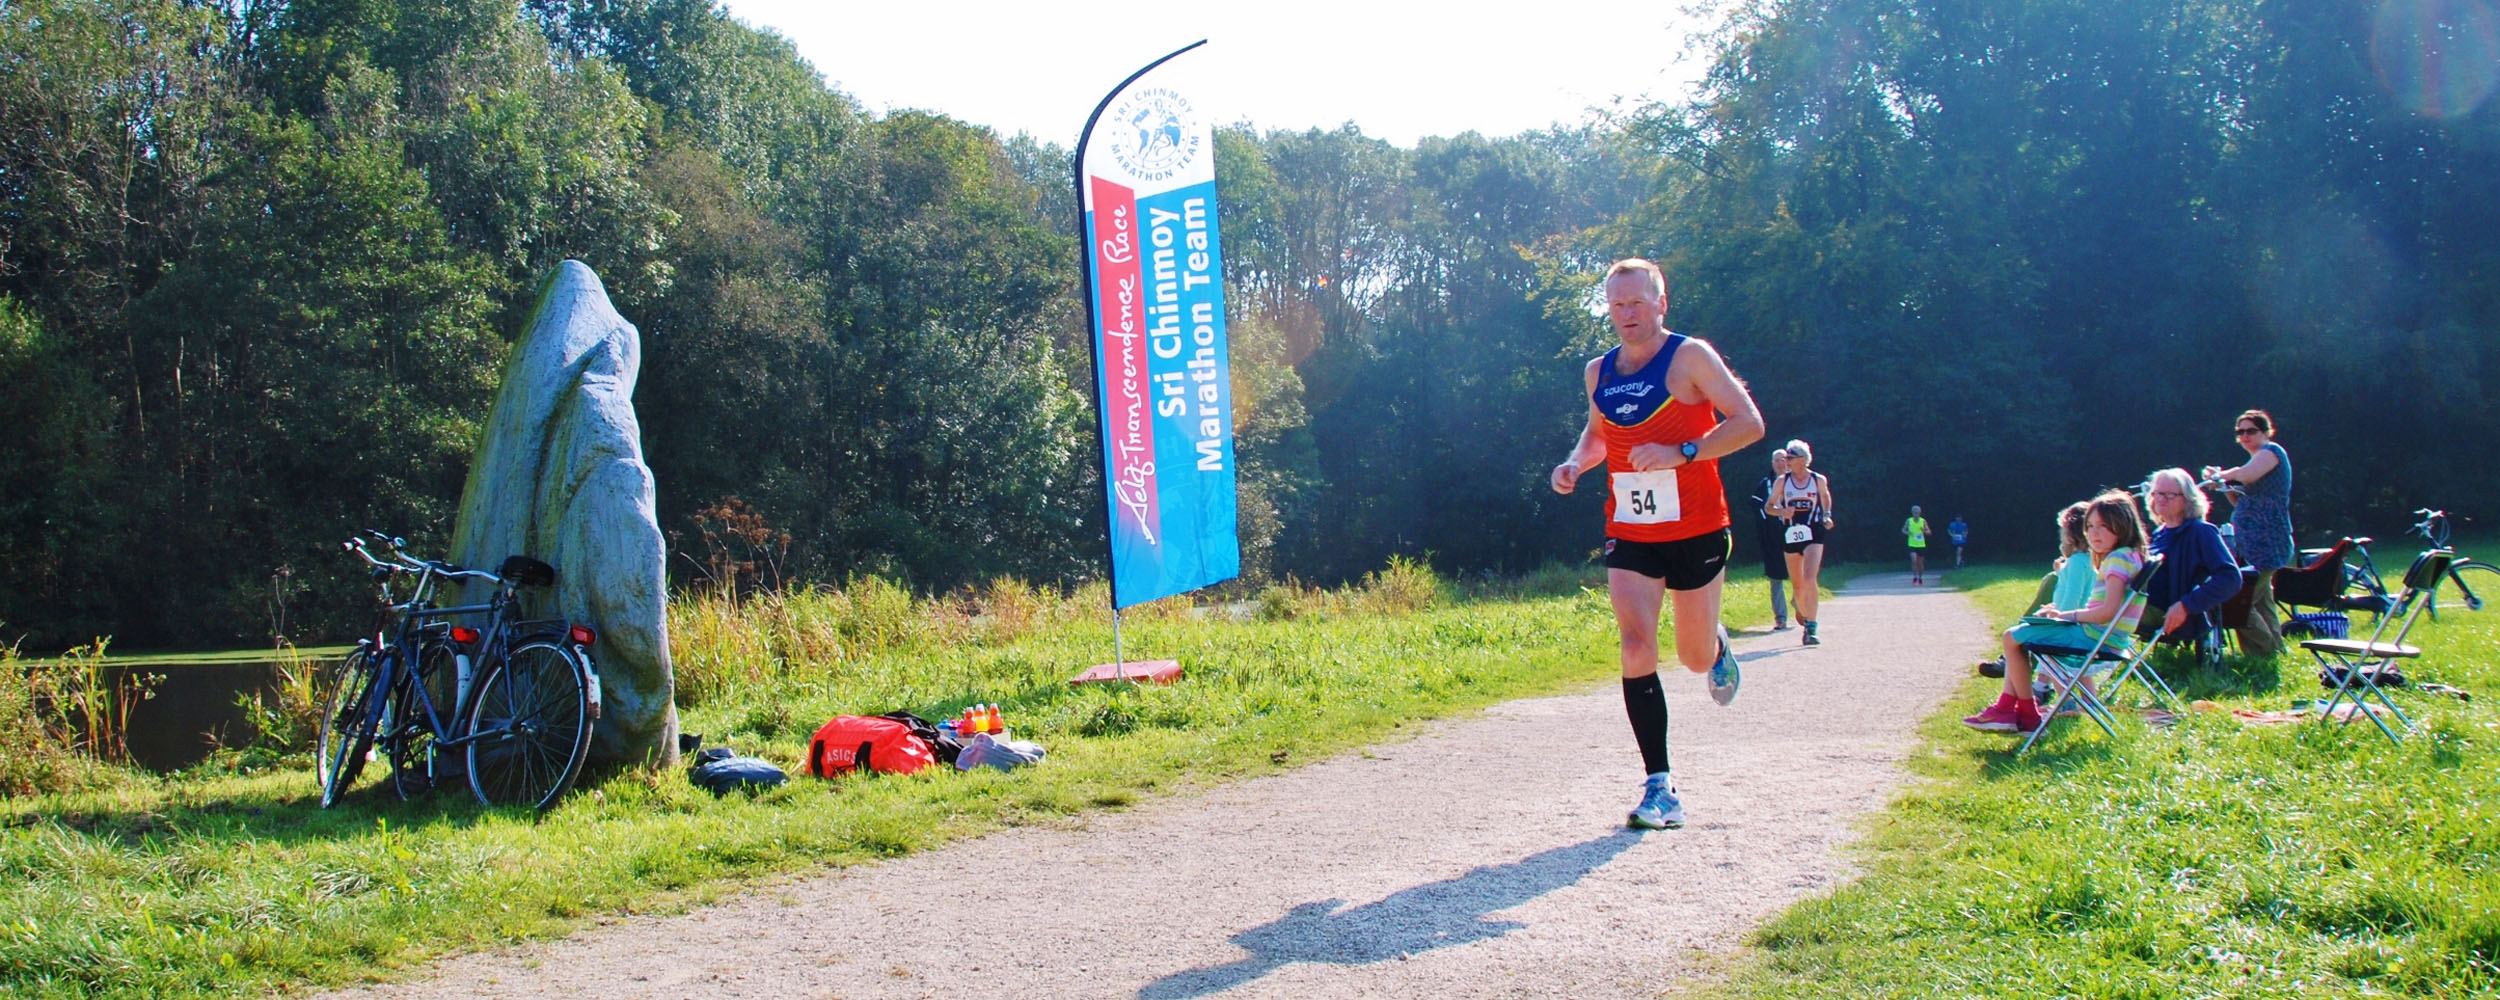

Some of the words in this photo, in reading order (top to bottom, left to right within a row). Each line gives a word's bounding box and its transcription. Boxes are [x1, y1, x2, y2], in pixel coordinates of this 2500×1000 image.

[1114, 102, 1131, 122] SRI
[1135, 88, 1193, 113] CHINMOY
[1111, 144, 1173, 181] MARATHON
[1177, 135, 1199, 169] TEAM
[1103, 204, 1133, 263] Race
[1183, 198, 1211, 292] Team
[1149, 207, 1182, 359] Chinmoy
[1153, 371, 1187, 417] Sri
[1186, 302, 1223, 471] Marathon
[1631, 489, 1656, 515] 54
[1793, 531, 1804, 541] 30
[827, 749, 857, 764] ASICS
